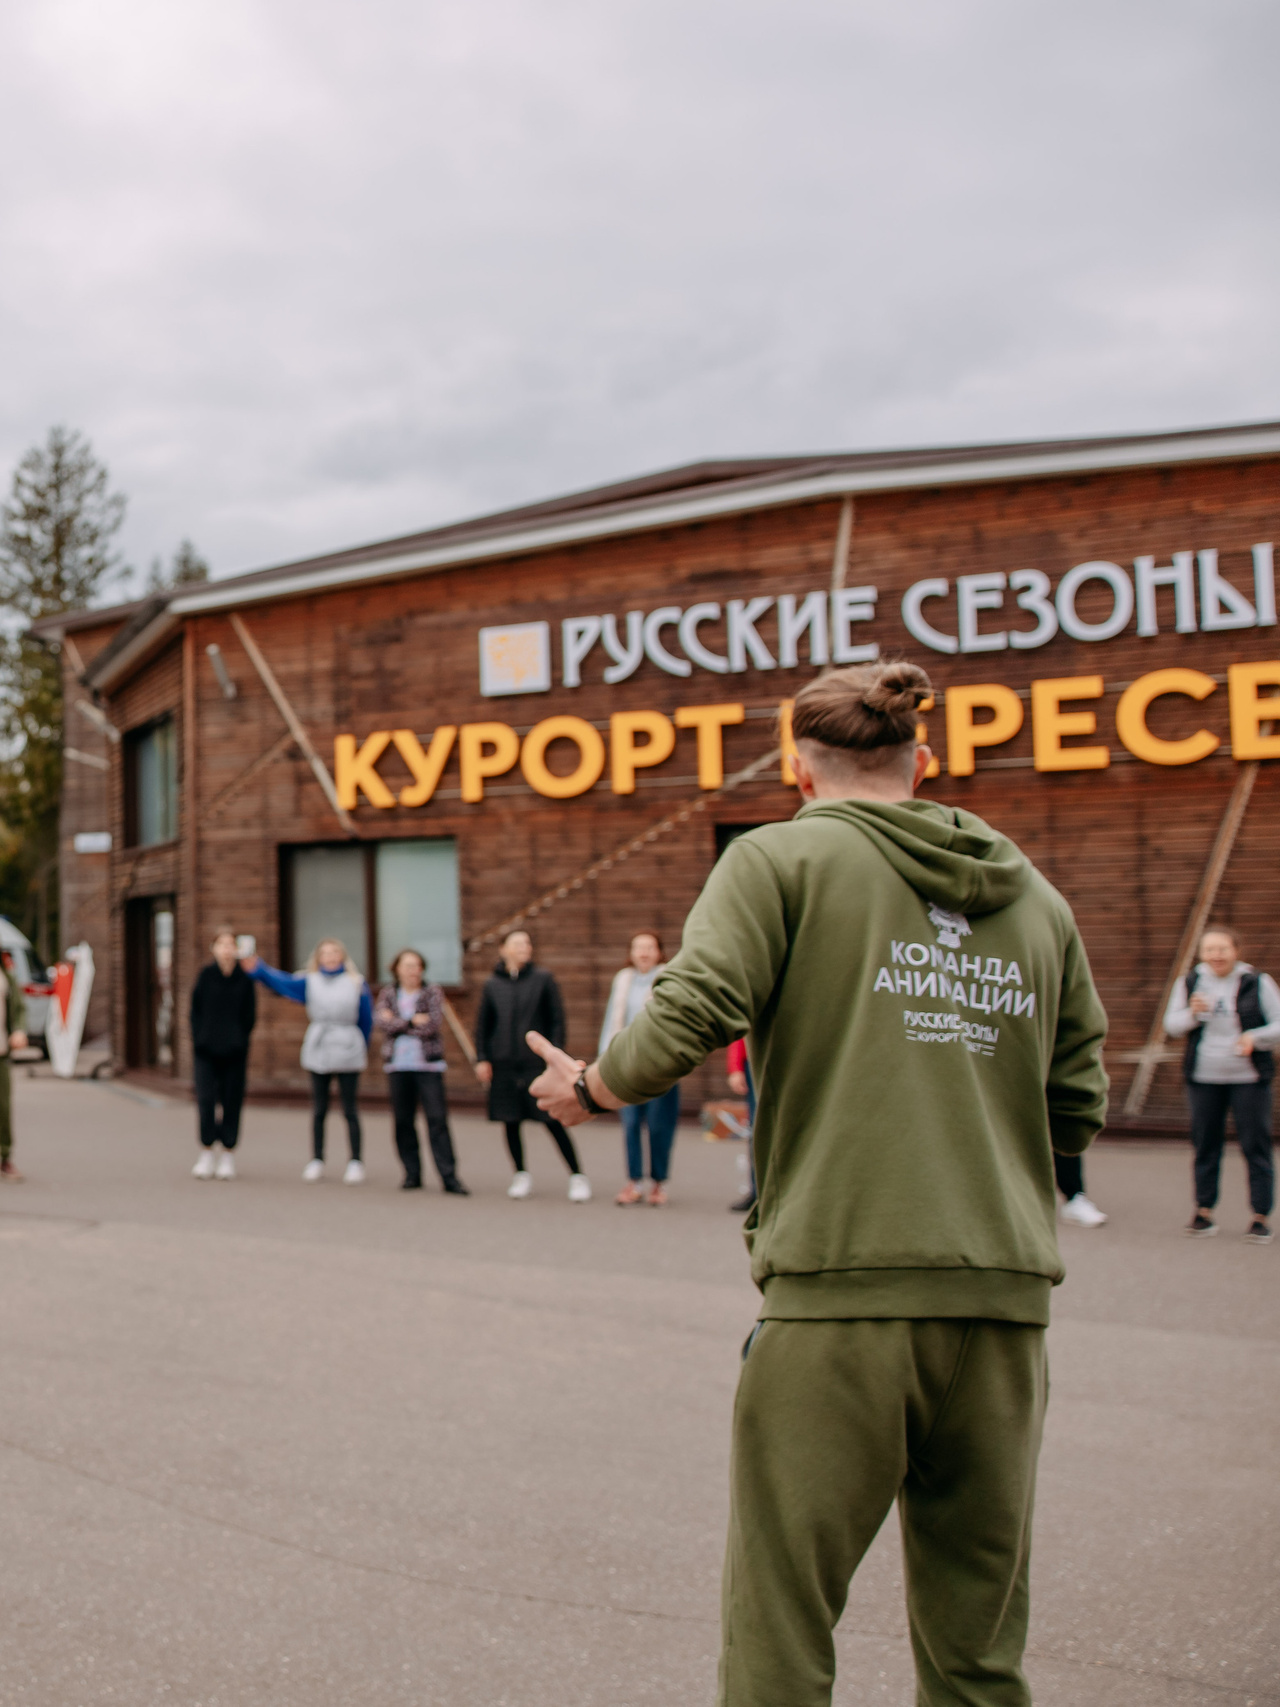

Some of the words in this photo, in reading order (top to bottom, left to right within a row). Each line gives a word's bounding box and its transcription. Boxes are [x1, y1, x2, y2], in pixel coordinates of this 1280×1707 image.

[561, 586, 880, 688] РУССКИЕ
[901, 542, 1278, 654] СЕЗОНЫ
[334, 703, 744, 810] КУРОРТ
